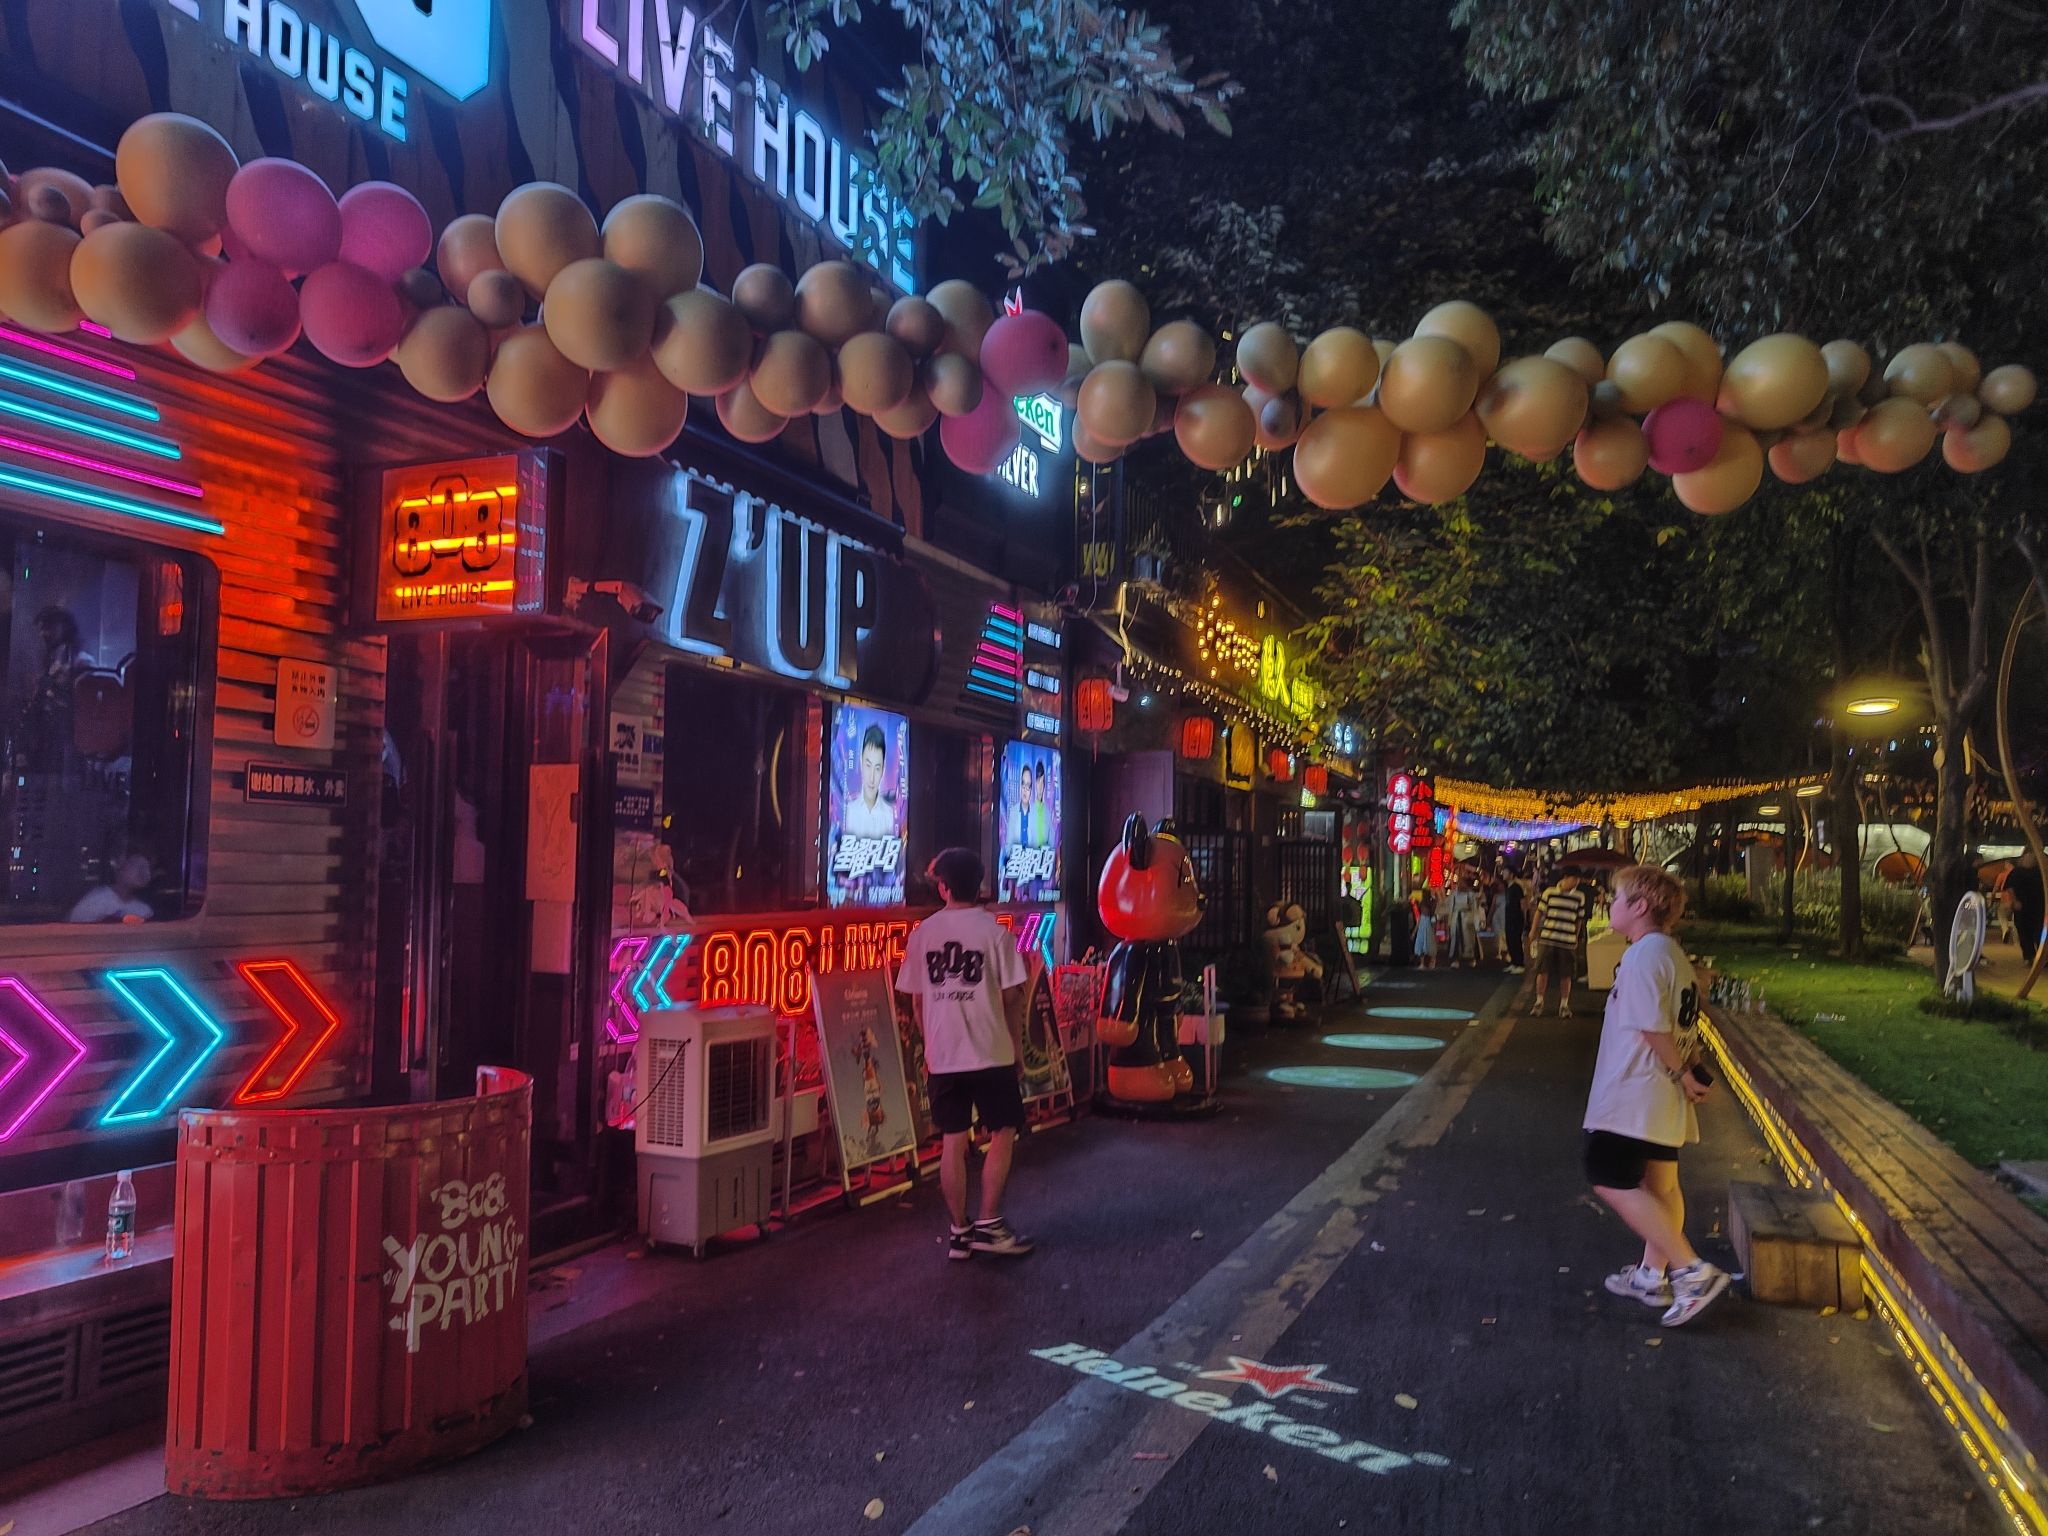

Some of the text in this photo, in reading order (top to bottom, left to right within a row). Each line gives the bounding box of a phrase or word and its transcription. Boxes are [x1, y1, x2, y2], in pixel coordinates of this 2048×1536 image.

[223, 0, 407, 142] HOUSE
[753, 66, 915, 296] HOUSE
[997, 443, 1039, 499] ILVER
[401, 581, 489, 609] LIVE HOUSE
[701, 926, 814, 1016] 808
[926, 941, 984, 986] 808
[382, 1215, 524, 1304] YOUNG
[405, 1257, 519, 1353] PARTY
[1030, 1342, 1413, 1475] Heineken
